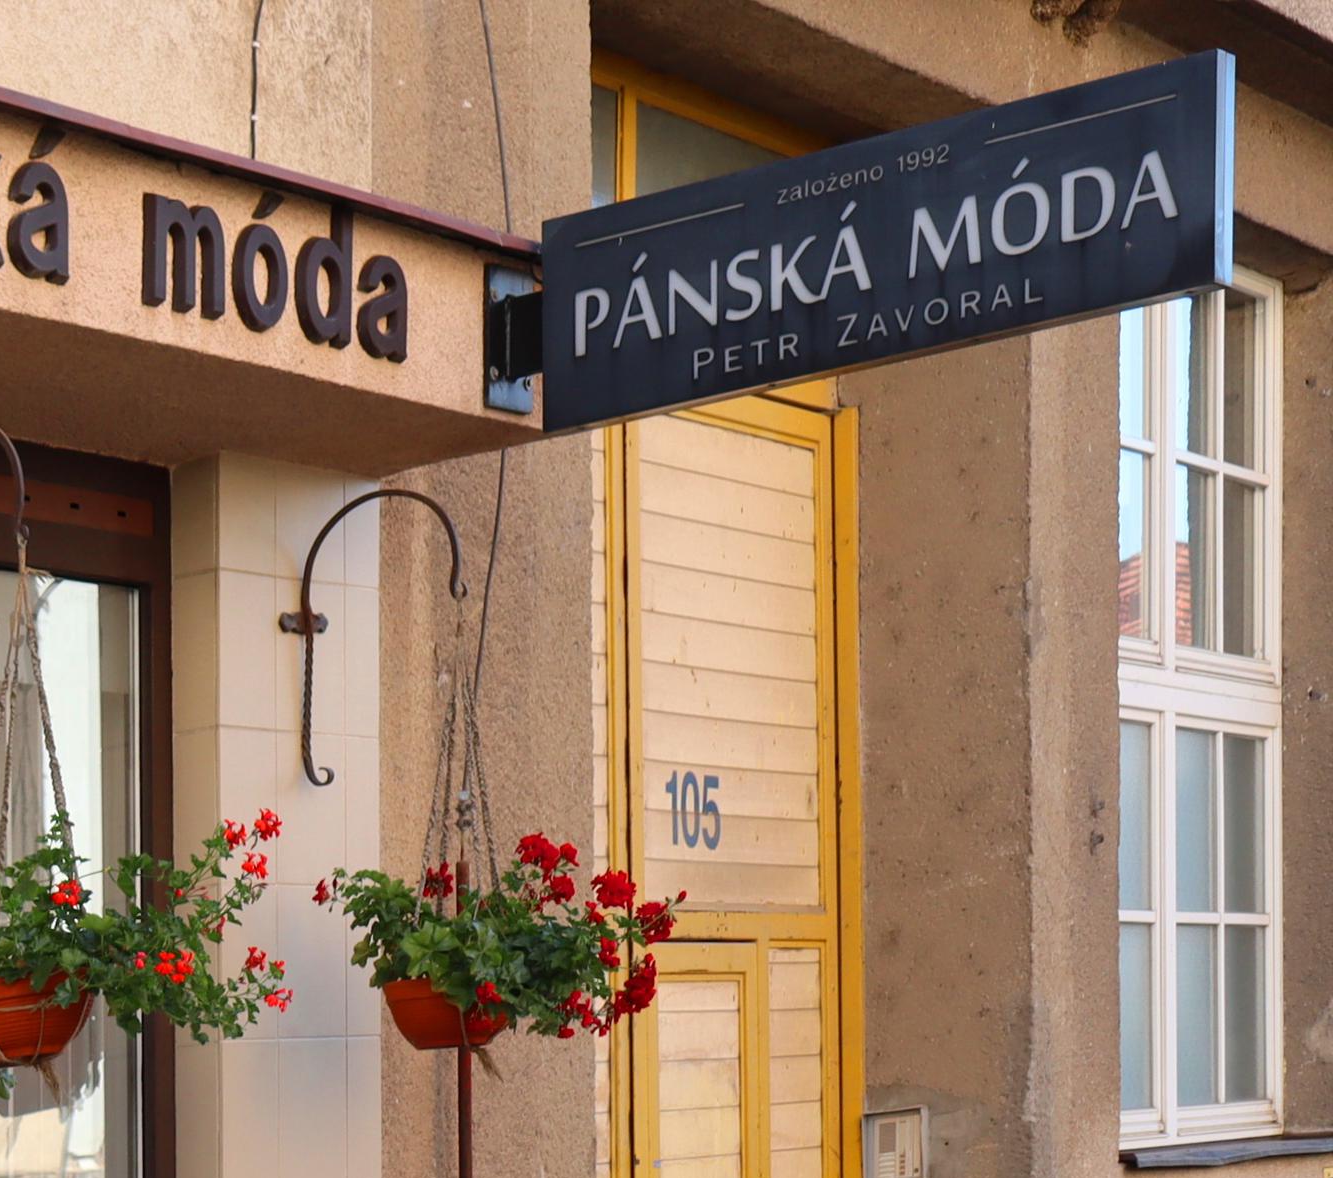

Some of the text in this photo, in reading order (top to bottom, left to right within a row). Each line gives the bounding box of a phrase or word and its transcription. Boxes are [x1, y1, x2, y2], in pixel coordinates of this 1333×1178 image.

[776, 143, 951, 205] založeno 1992
[141, 190, 408, 364] móda
[574, 149, 1179, 357] PÁNSKÁ MÓDA
[692, 277, 1044, 380] PETR ZAVORAL
[665, 769, 721, 850] 105
